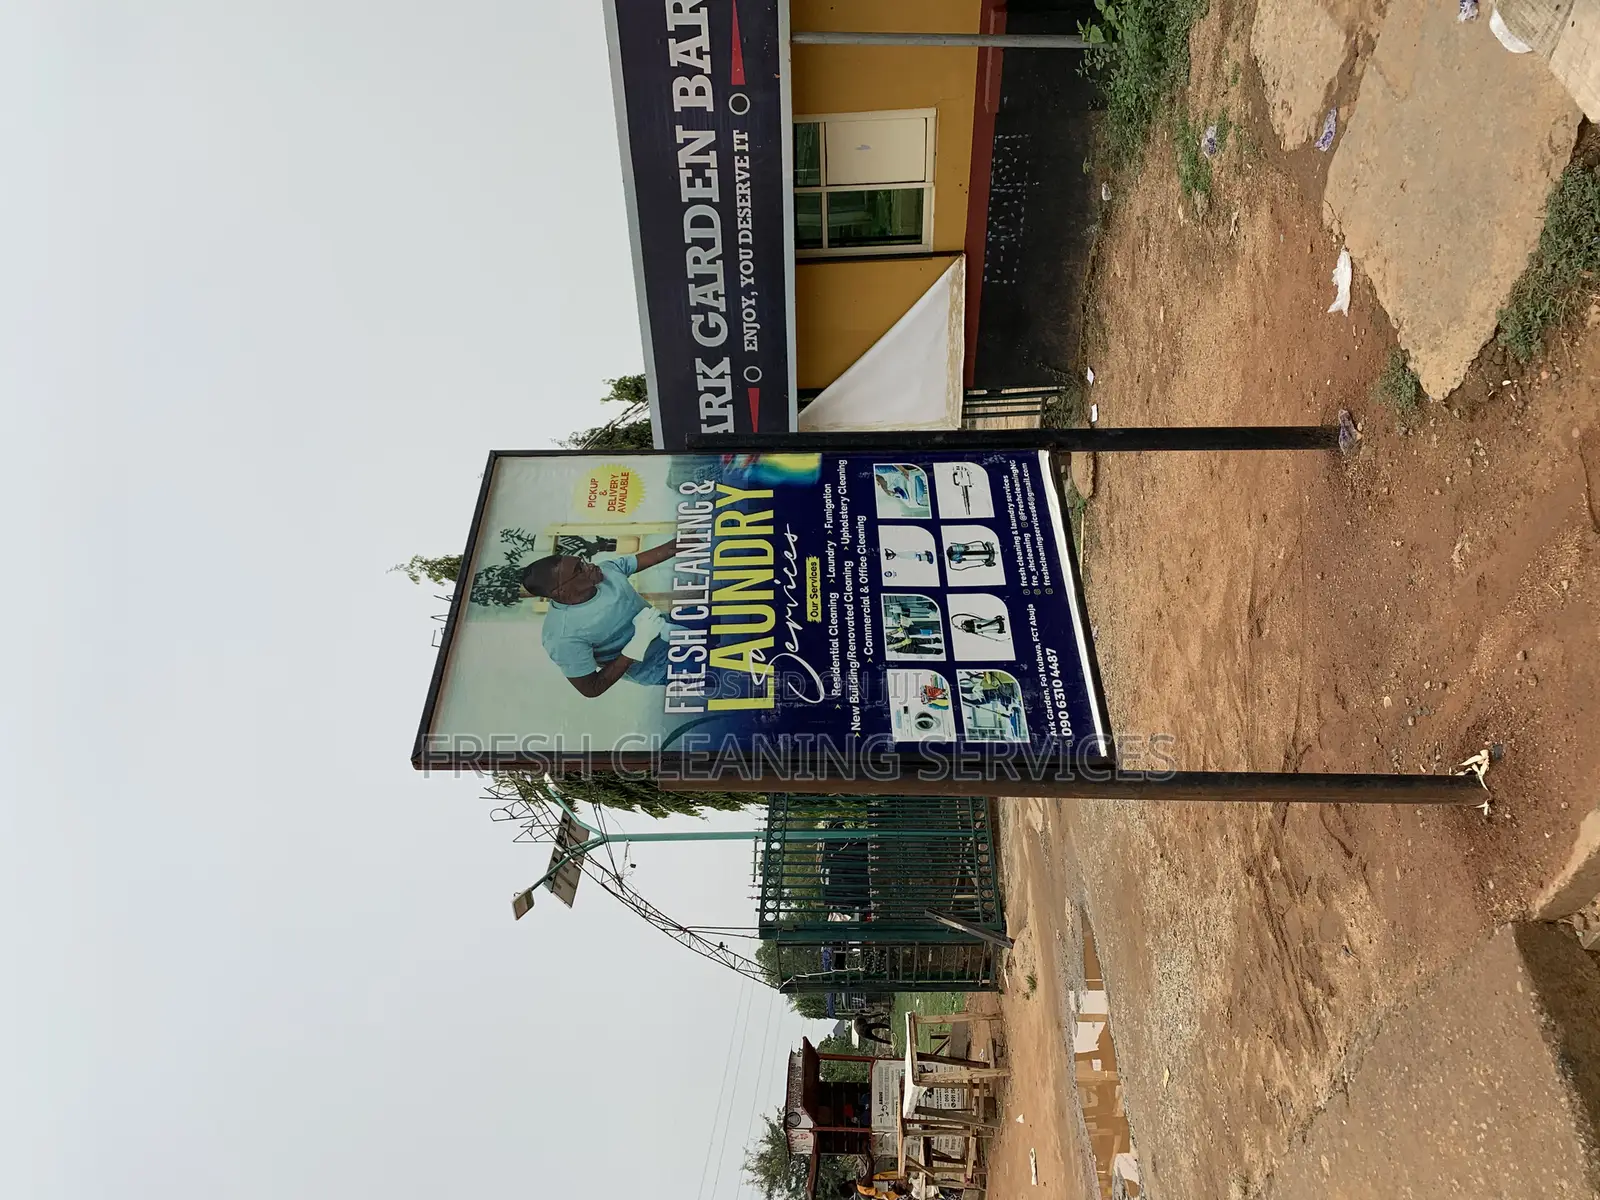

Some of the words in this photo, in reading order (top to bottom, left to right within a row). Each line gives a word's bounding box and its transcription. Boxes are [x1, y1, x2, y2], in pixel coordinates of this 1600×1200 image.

[732, 129, 749, 152] IT
[734, 155, 753, 245] DESERVE
[675, 124, 729, 347] GARDEN
[738, 247, 755, 288] YOU
[740, 290, 761, 352] ENJOY,
[587, 478, 599, 508] PICKUP
[607, 474, 619, 512] DELIVERY
[617, 471, 630, 513] AVAILABLE
[679, 479, 715, 495] &
[837, 459, 848, 495] Cleaning
[1002, 474, 1013, 503] services
[822, 483, 835, 529] Fumigation
[839, 496, 852, 545] Upholstery
[1007, 503, 1018, 530] laundry
[1020, 462, 1051, 586] freshcleaningservices66@gmail.com
[856, 515, 867, 555] Cleaning
[1012, 535, 1024, 567] cleaning
[669, 501, 714, 621] CLEANING
[825, 540, 837, 578] Laundry
[858, 556, 869, 584] Office
[1017, 567, 1028, 587] fresh
[1022, 532, 1039, 587] fre_shcleaning
[707, 483, 776, 711] LAUNDRY
[809, 561, 818, 600] Services
[842, 560, 854, 602] Cleaning
[859, 585, 870, 593] &
[749, 523, 825, 704] Services
[809, 601, 819, 618] Our
[828, 592, 839, 636] Cleaning
[860, 595, 874, 656] Commercial
[1026, 603, 1037, 627] Abuja
[1030, 626, 1040, 642] FCT
[664, 629, 708, 714] FRESH
[829, 638, 842, 696] Residential
[844, 603, 860, 704] Building/Renovated
[1034, 642, 1046, 673] Kubwa,
[1045, 647, 1061, 678] 4487
[1042, 687, 1054, 720] Garden,
[1052, 679, 1067, 709] 6310
[851, 706, 861, 731] New
[1048, 721, 1058, 737] Ark
[1058, 710, 1073, 737] 090
